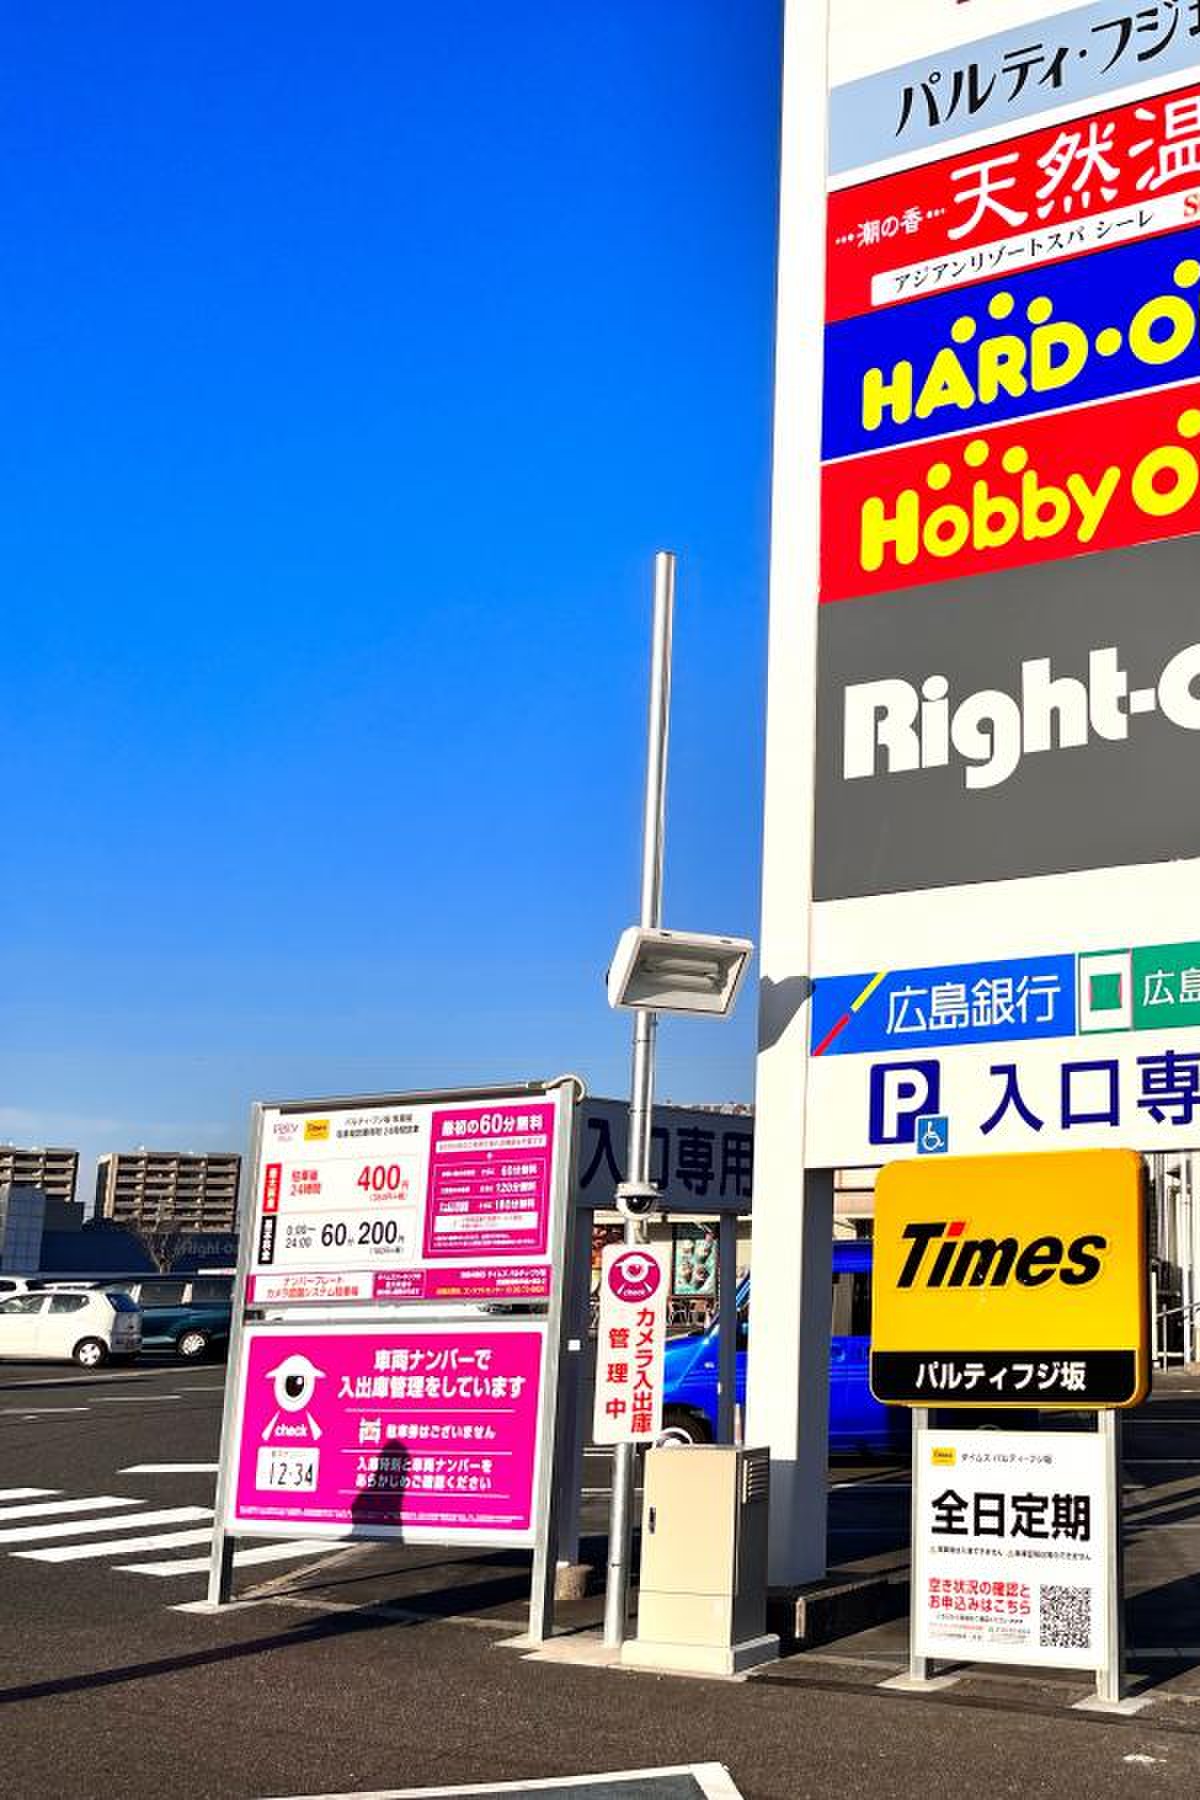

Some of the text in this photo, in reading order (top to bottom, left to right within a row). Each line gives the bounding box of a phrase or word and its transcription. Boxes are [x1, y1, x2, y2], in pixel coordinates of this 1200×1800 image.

[1096, 209, 1154, 240] シーレ
[861, 466, 1121, 572] Hobby
[885, 973, 1062, 1035] 広島銀行
[896, 1221, 1108, 1289] Times
[374, 1348, 493, 1372] 車両ナンバーで
[604, 1327, 630, 1420] 管理中
[630, 1307, 656, 1434] カメラ入出庫
[915, 1360, 1087, 1391] パルティフジ坂
[337, 1375, 526, 1399] 入出庫管理をしています
[931, 1488, 1091, 1542] 全日定期
[928, 1576, 1031, 1599] 空き状況の確認と
[928, 1594, 1031, 1615] お申込みはこちら
